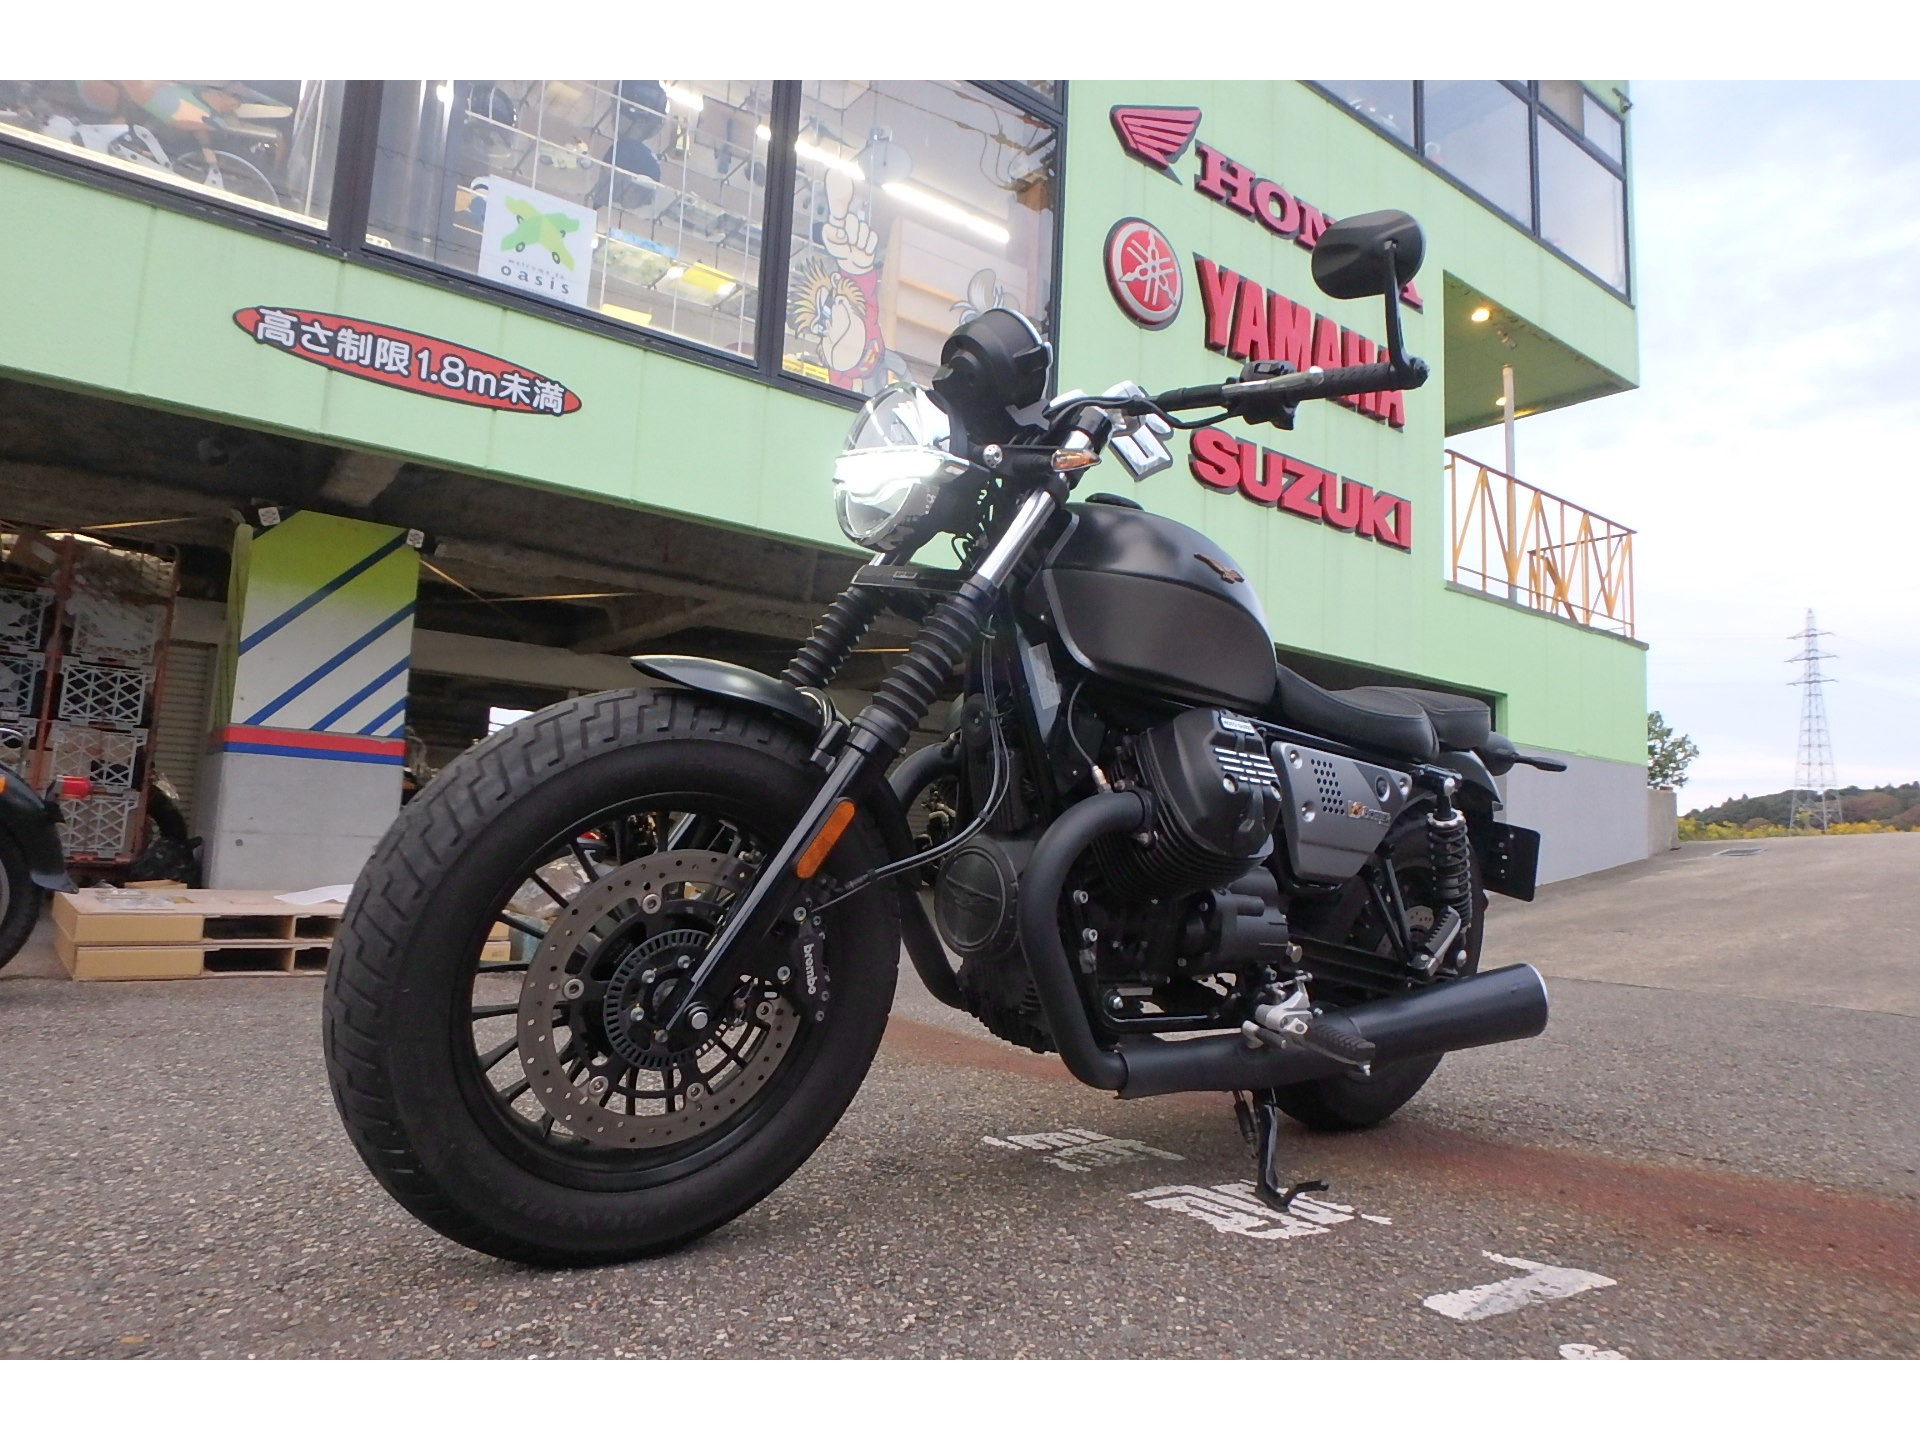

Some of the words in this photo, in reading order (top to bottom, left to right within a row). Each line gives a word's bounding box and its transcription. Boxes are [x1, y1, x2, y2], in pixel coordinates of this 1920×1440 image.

[500, 265, 570, 294] oasis
[1195, 139, 1424, 314] HON
[256, 307, 566, 415] 高さ制限1.8m未満
[1189, 427, 1412, 555] SUZUKI
[803, 943, 818, 995] brembo
